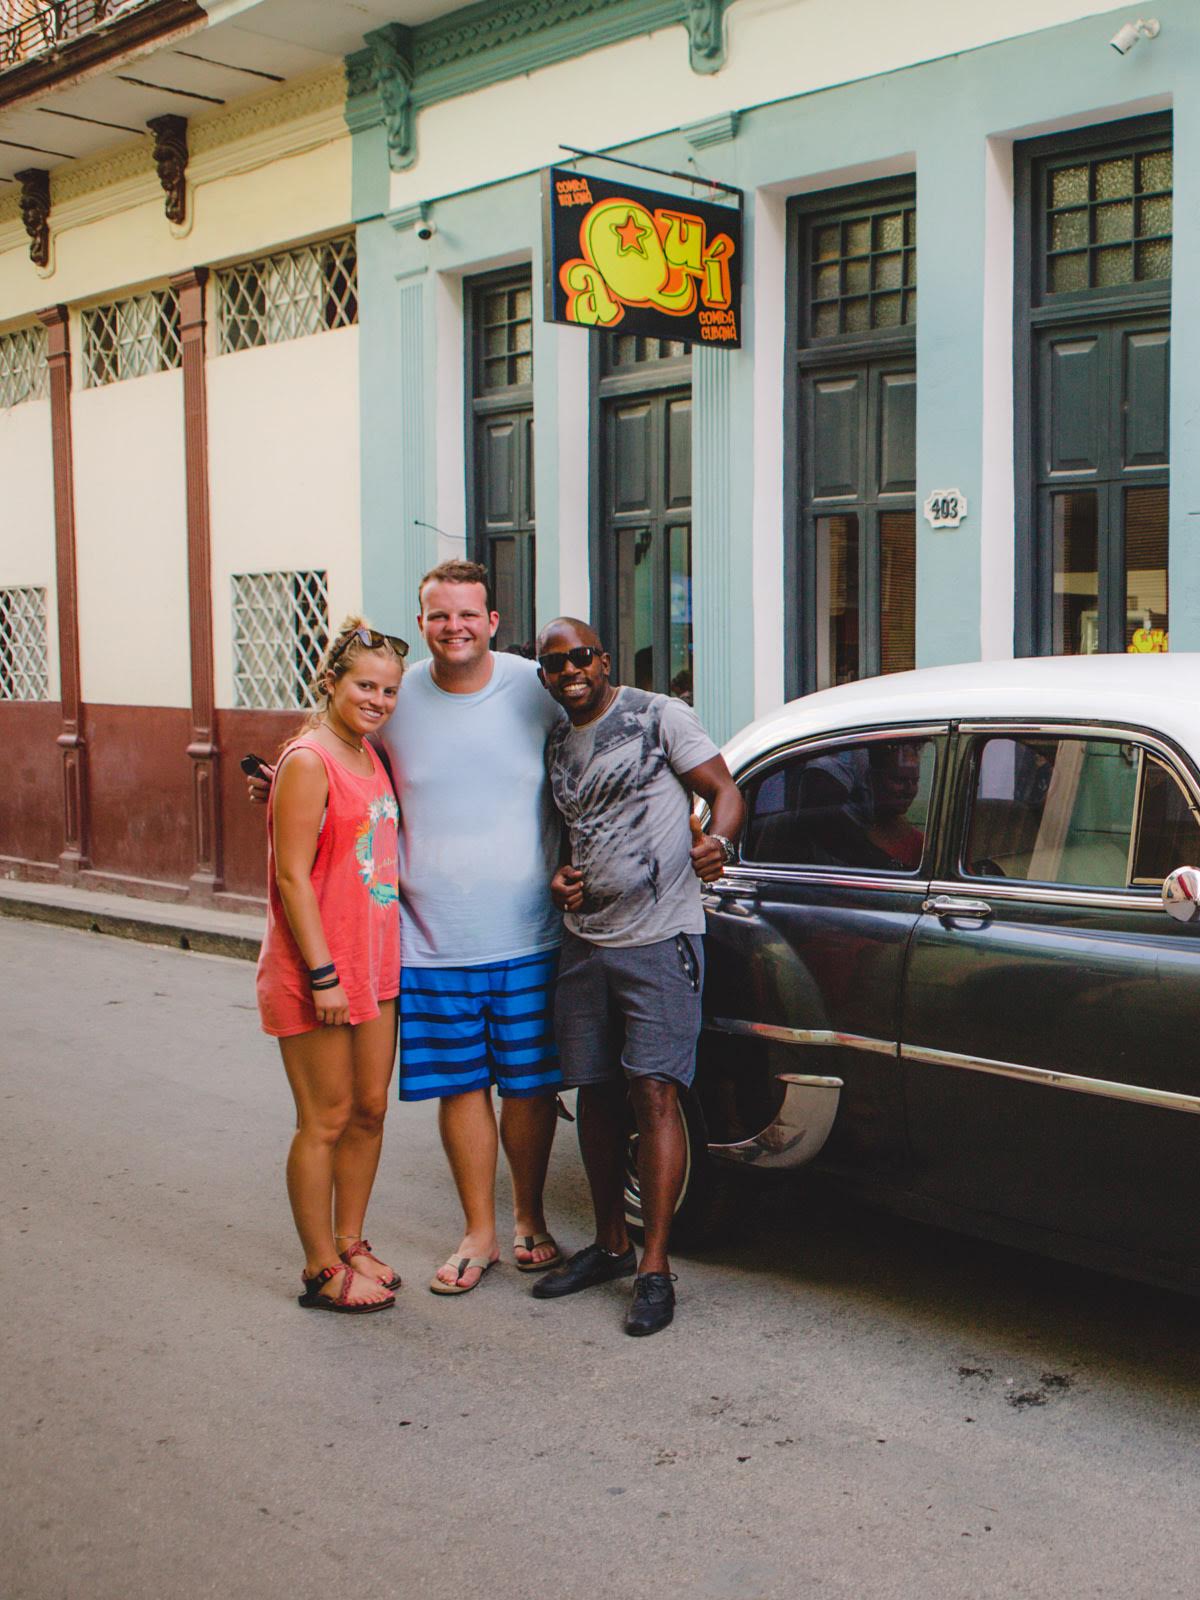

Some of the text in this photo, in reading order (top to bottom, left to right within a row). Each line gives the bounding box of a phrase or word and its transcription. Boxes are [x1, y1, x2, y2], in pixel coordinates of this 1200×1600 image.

[555, 178, 588, 193] COMIDA
[698, 310, 735, 325] COMIDA
[701, 325, 737, 341] CUBANA
[930, 497, 958, 520] 403
